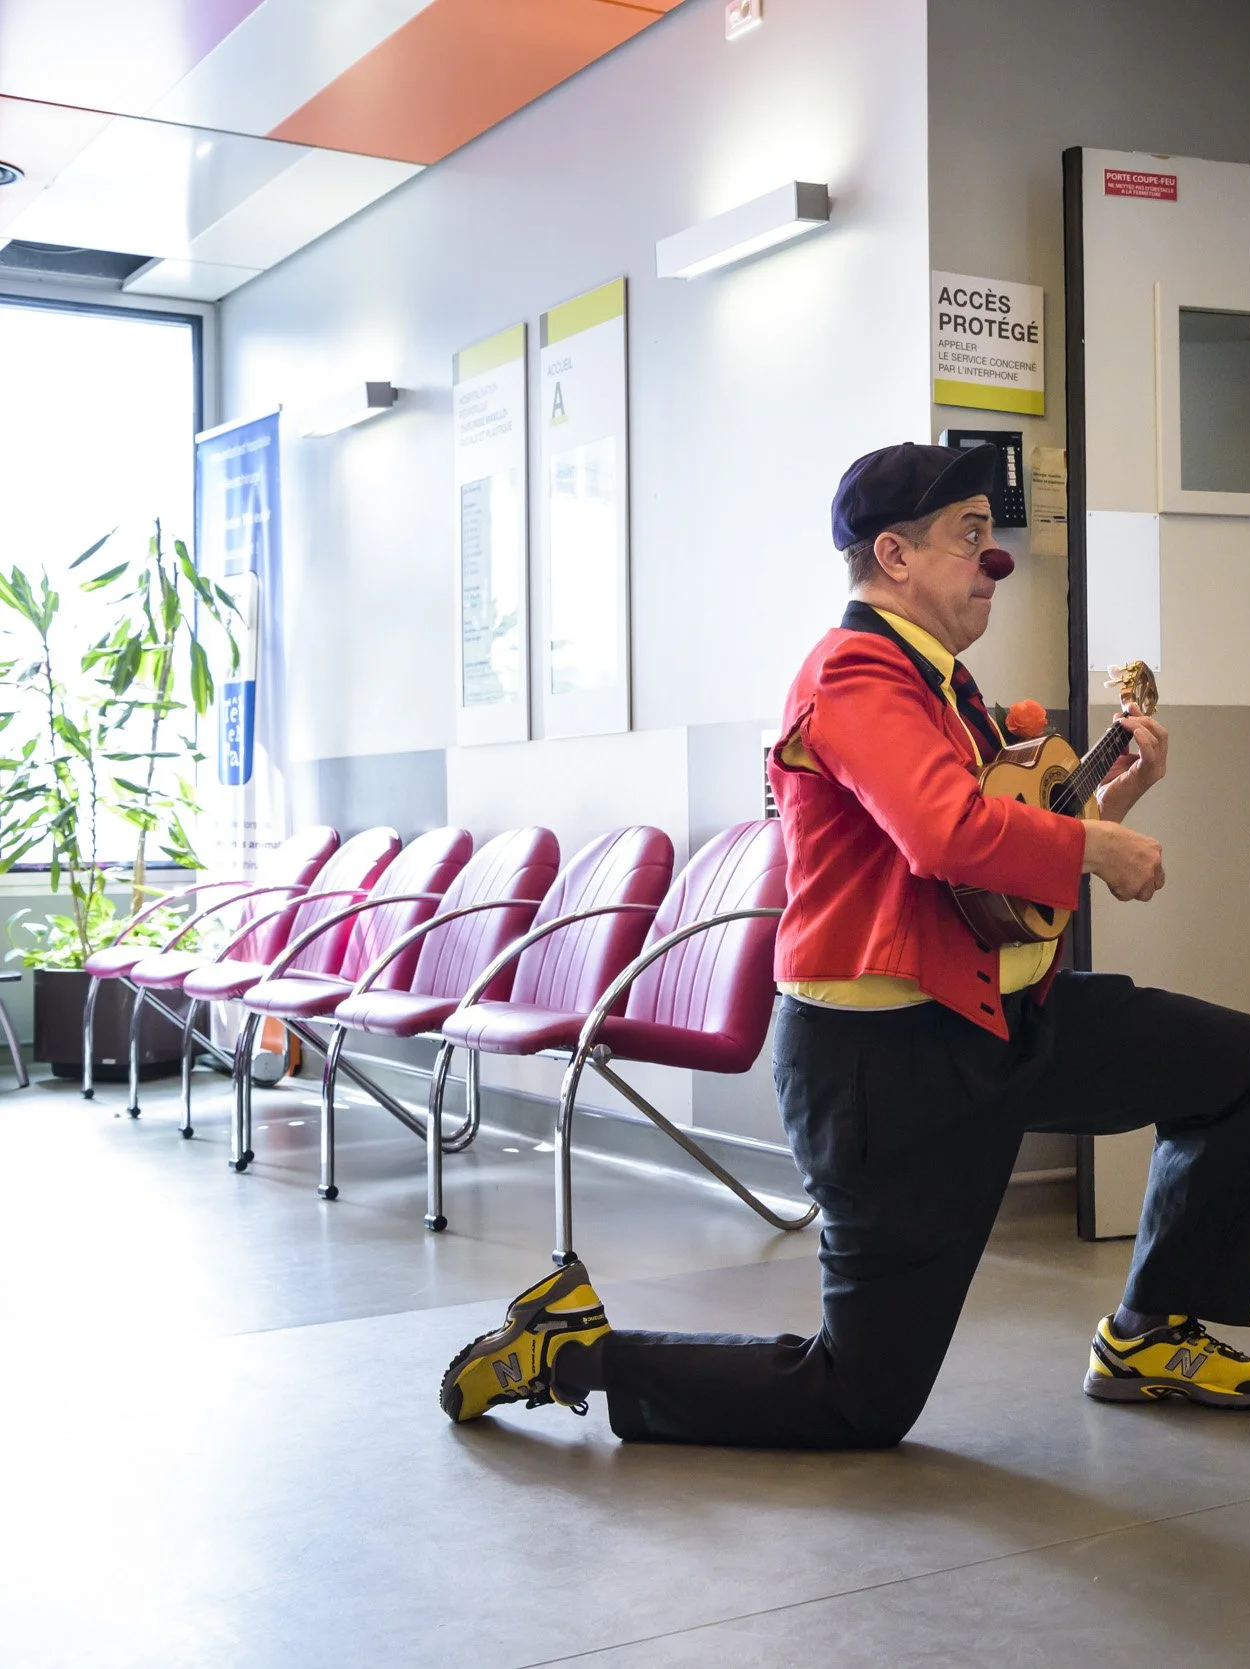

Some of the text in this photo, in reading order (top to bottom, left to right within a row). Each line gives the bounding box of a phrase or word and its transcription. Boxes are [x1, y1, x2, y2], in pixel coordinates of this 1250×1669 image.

[1106, 172, 1175, 186] PORTE COUPE-FEU
[938, 286, 1011, 314] ACCÈS
[939, 312, 1039, 344] PROTÉGÉ
[938, 339, 978, 352] APPELER
[938, 352, 1037, 372] LE SERVICE CONCERNÉ
[938, 363, 1019, 381] PAR L'INTERPHONE
[551, 381, 565, 420] A
[1165, 1347, 1208, 1379] N
